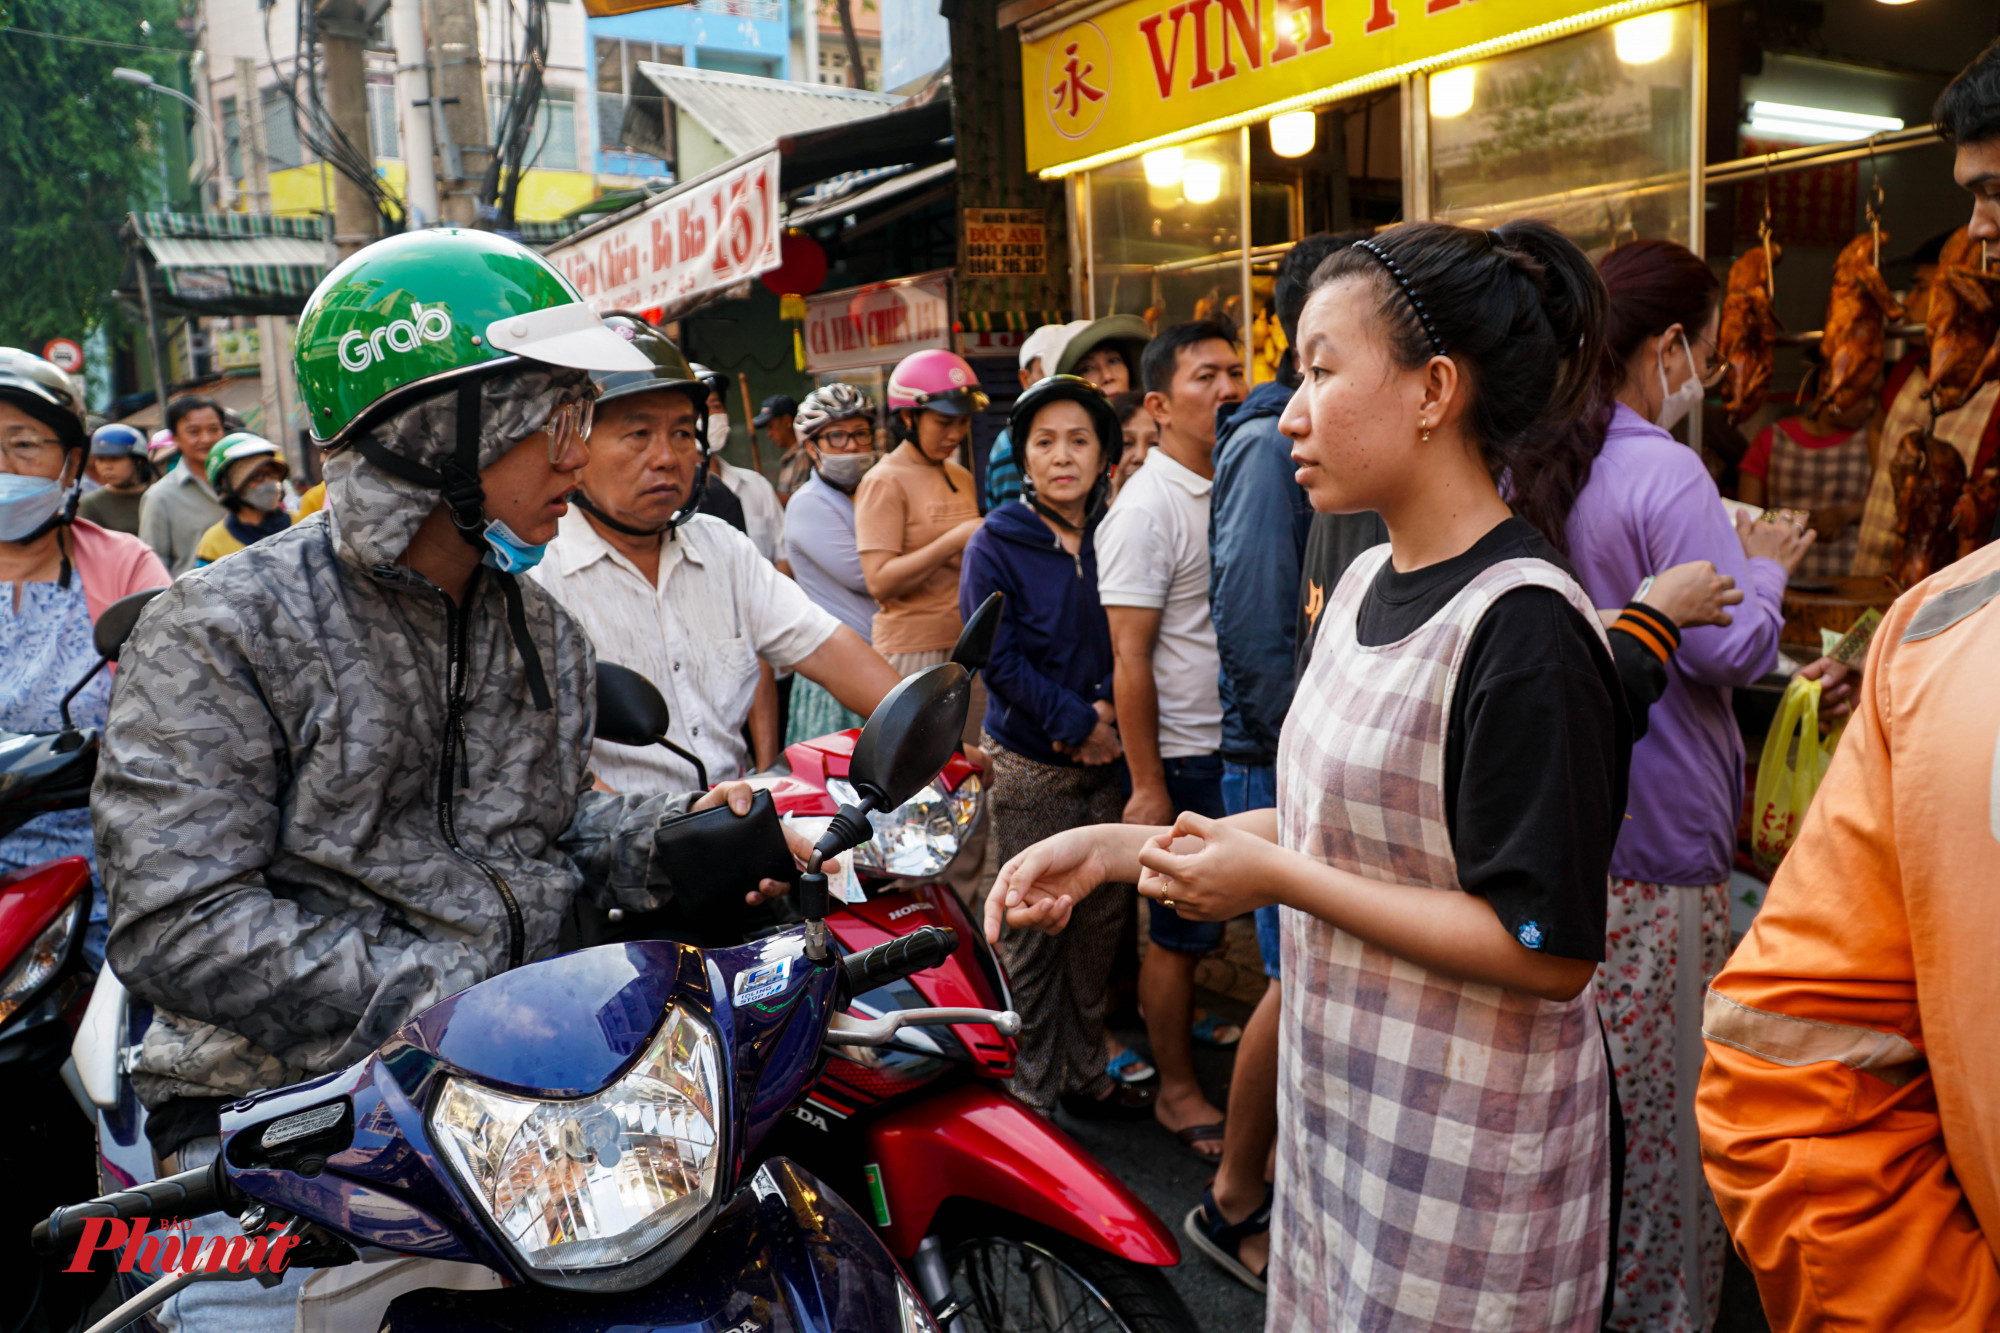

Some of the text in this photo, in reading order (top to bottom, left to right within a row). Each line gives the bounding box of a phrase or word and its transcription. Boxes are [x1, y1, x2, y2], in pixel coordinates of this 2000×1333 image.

[1051, 42, 1107, 118] 永
[711, 165, 775, 281] 151
[1008, 227, 1042, 243] ANH
[338, 302, 452, 373] Grab
[810, 309, 830, 356] CÁ
[888, 902, 935, 921] HONDA
[740, 993, 764, 1005] STOP
[741, 986, 772, 999] IDLING
